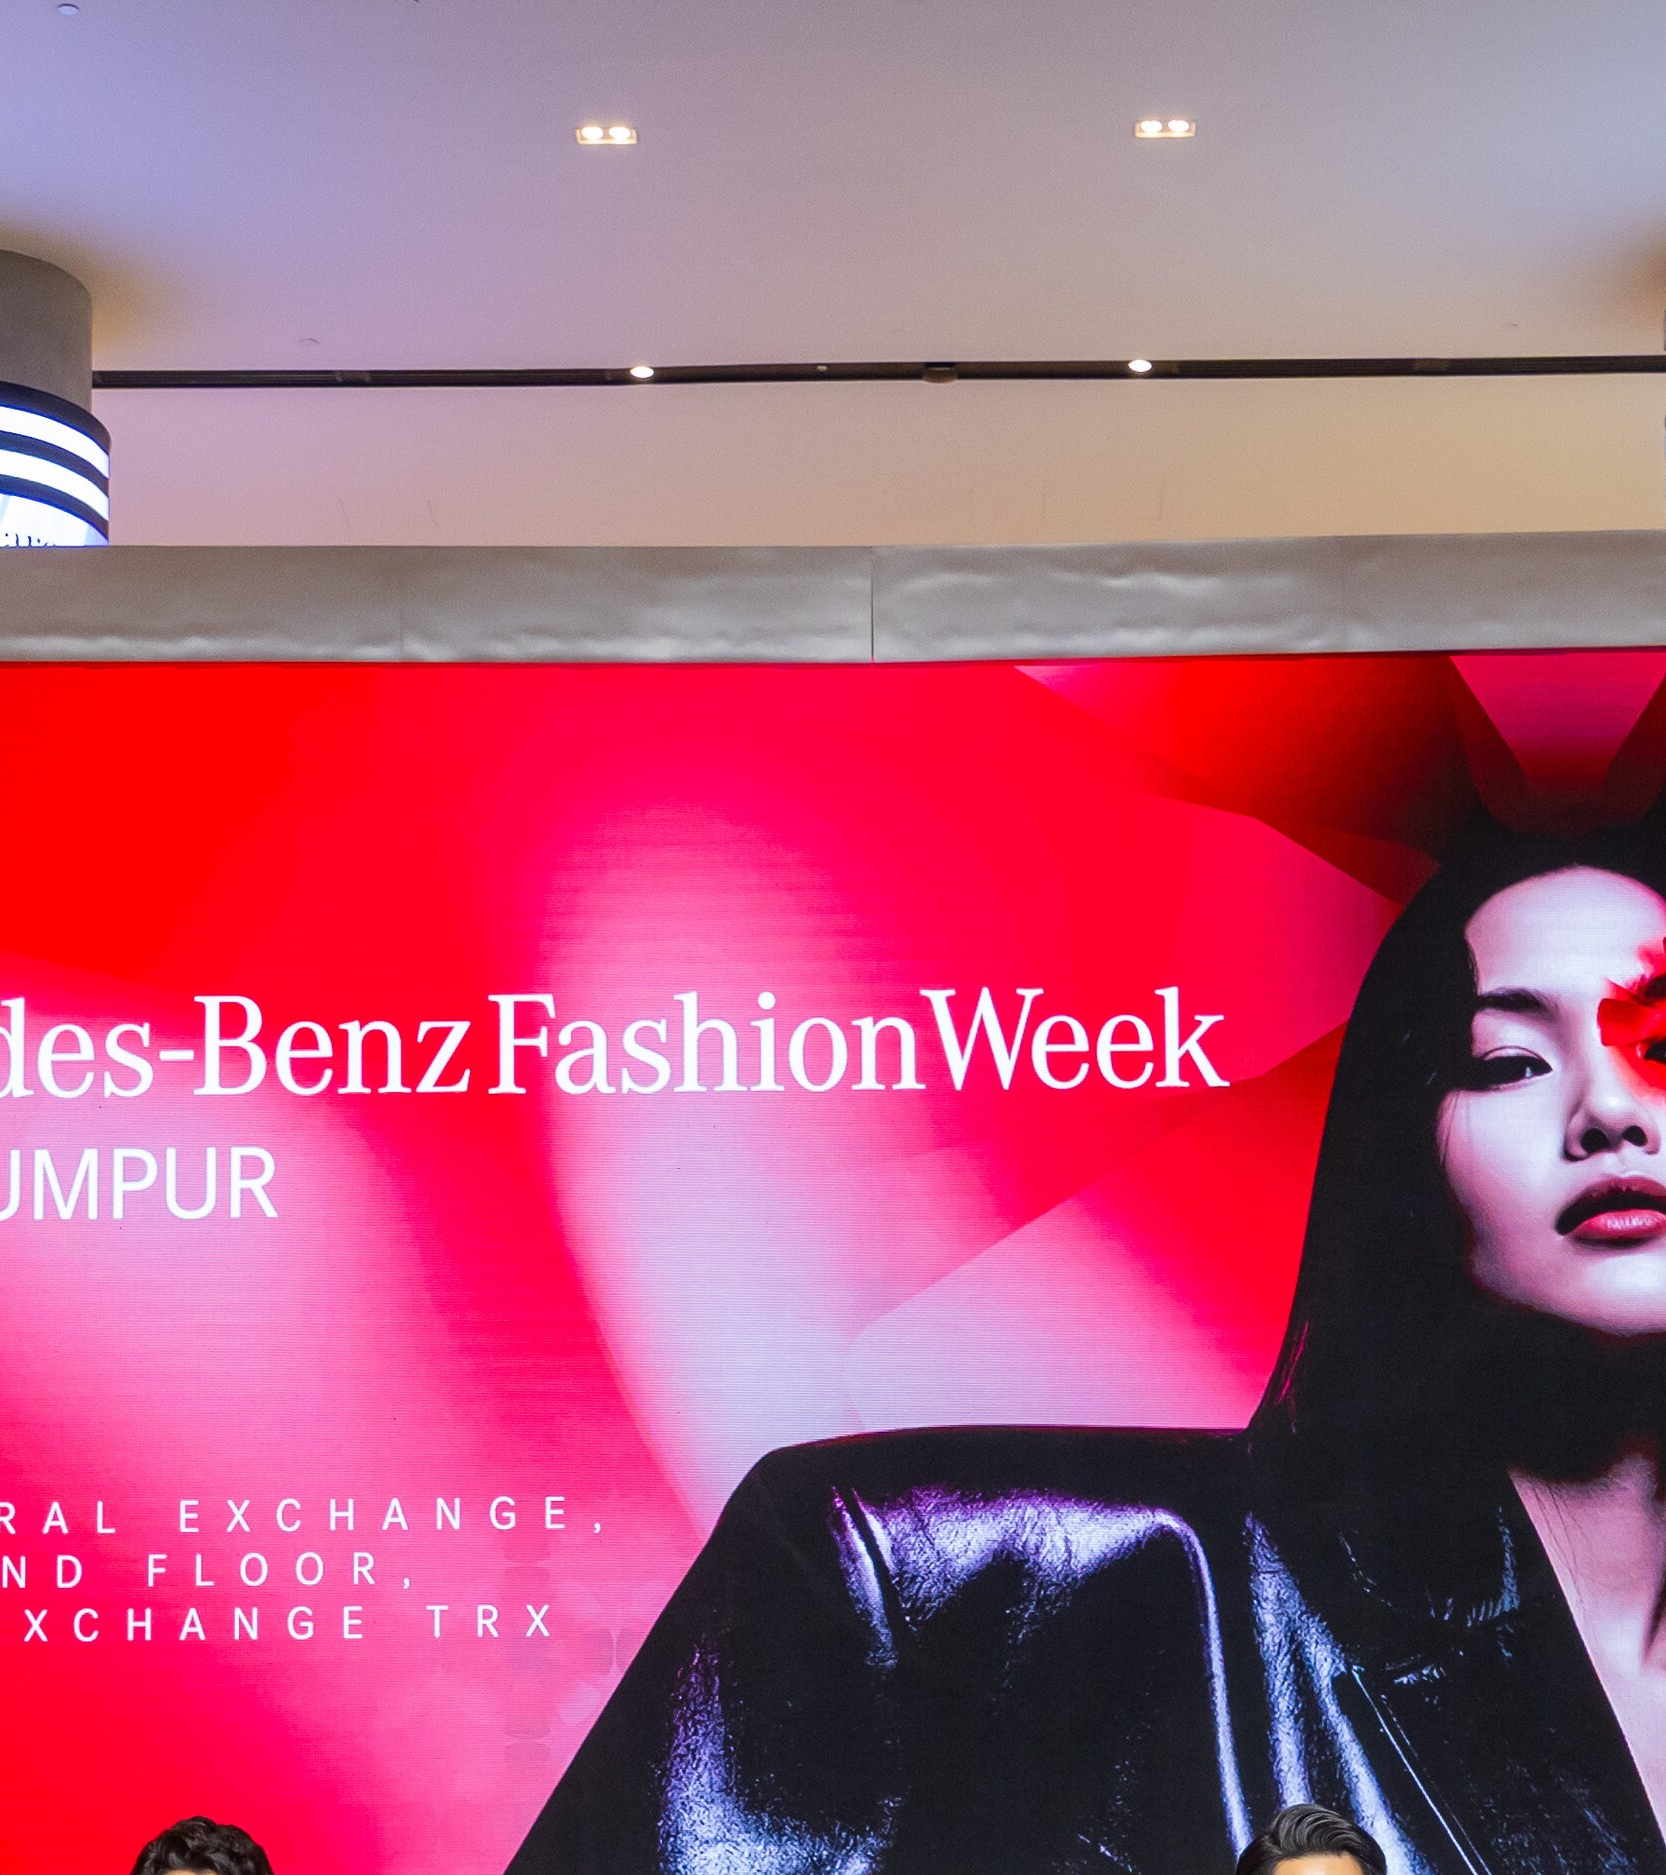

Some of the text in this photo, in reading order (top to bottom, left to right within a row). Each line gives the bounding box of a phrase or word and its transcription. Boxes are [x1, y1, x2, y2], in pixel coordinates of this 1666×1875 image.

[179, 1495, 601, 1534] EXCHANGE,
[148, 1551, 411, 1590] FLOOR,
[426, 1604, 550, 1638] TRX
